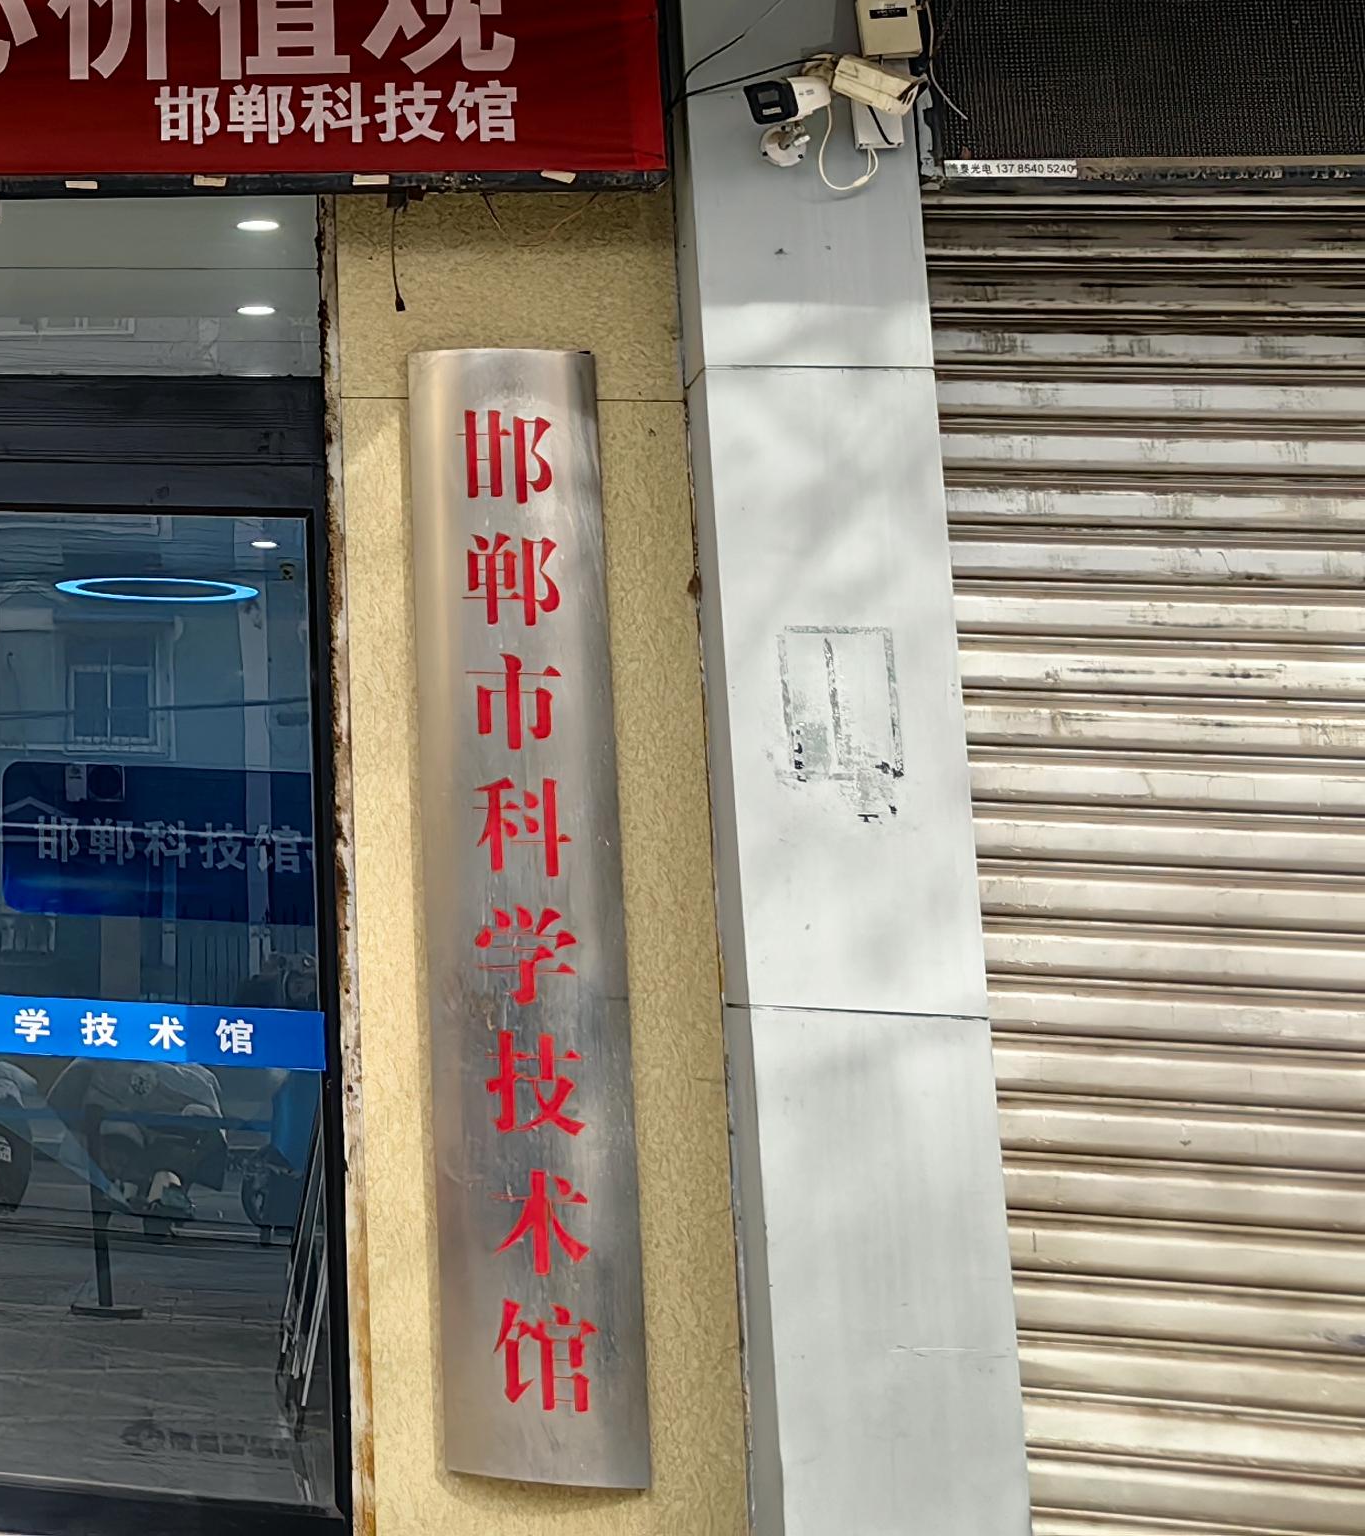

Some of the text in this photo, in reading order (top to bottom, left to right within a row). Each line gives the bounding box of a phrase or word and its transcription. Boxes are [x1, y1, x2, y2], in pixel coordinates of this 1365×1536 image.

[153, 79, 520, 146] 邯郸科技馆
[995, 163, 1015, 174] 137
[1017, 164, 1044, 174] 8540
[37, 814, 303, 874] 邯郸科技馆
[455, 407, 598, 1416] 邯郸市科学技术馆
